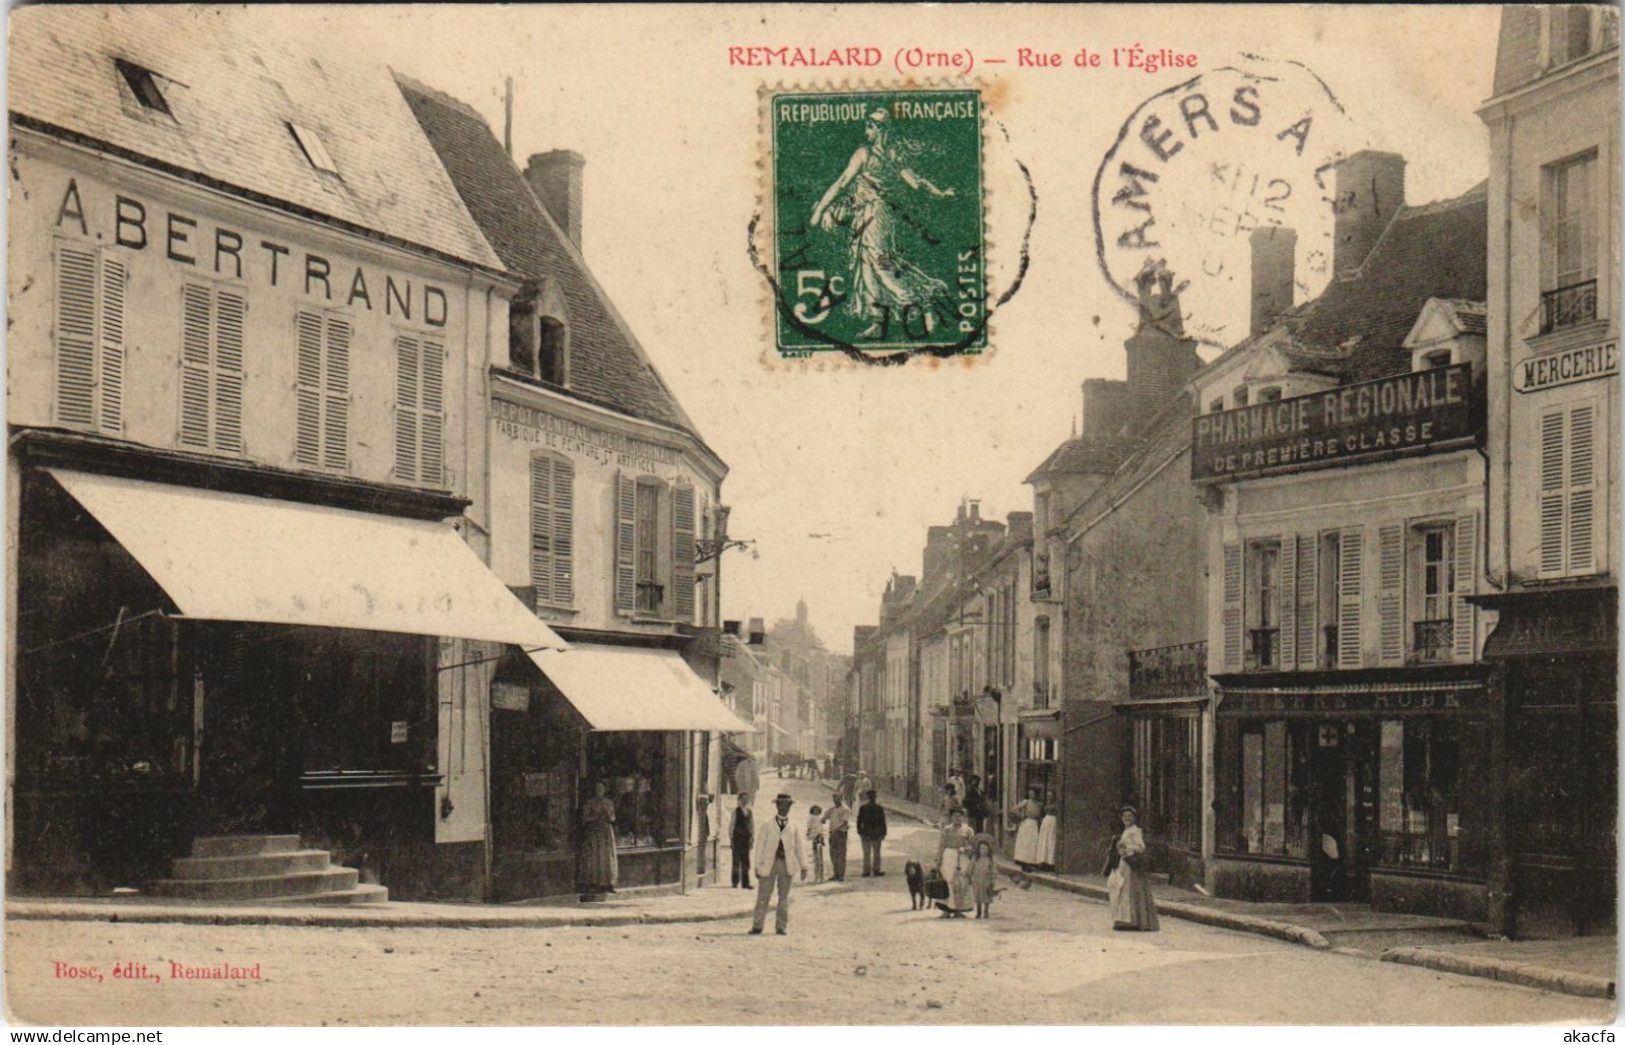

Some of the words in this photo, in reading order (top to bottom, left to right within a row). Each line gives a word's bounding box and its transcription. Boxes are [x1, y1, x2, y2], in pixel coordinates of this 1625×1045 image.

[893, 100, 976, 121] FRANÇAISE
[114, 194, 450, 329] BERTRAND
[958, 251, 978, 333] POSTES
[1523, 342, 1616, 389] MERCERIE
[1199, 399, 1311, 447] PHARMACIE
[1214, 454, 1236, 473] DE
[1346, 421, 1433, 451] CLASSE
